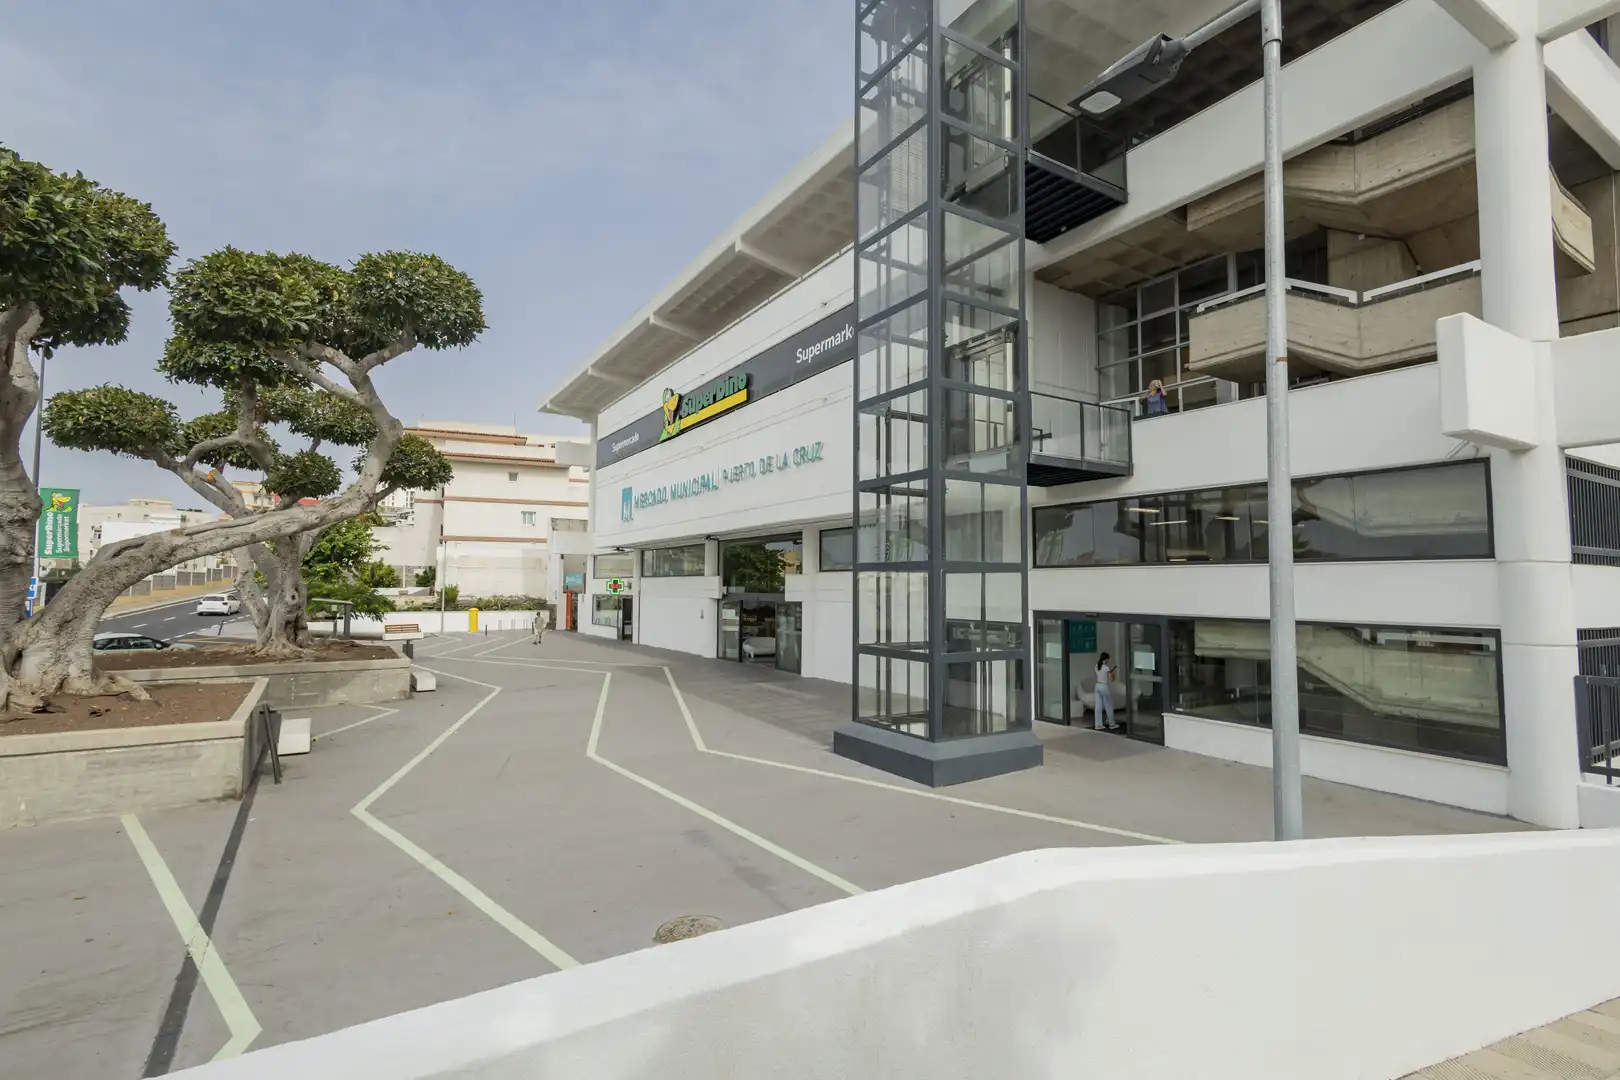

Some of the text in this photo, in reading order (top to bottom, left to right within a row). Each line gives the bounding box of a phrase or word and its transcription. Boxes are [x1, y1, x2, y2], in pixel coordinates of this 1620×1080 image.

[611, 432, 640, 453] Supermercado
[634, 441, 824, 509] MERCADO MUNICIPAL PUERTO DE LA CRUZ
[55, 514, 63, 554] Supermercado
[63, 516, 71, 552] Supermarket
